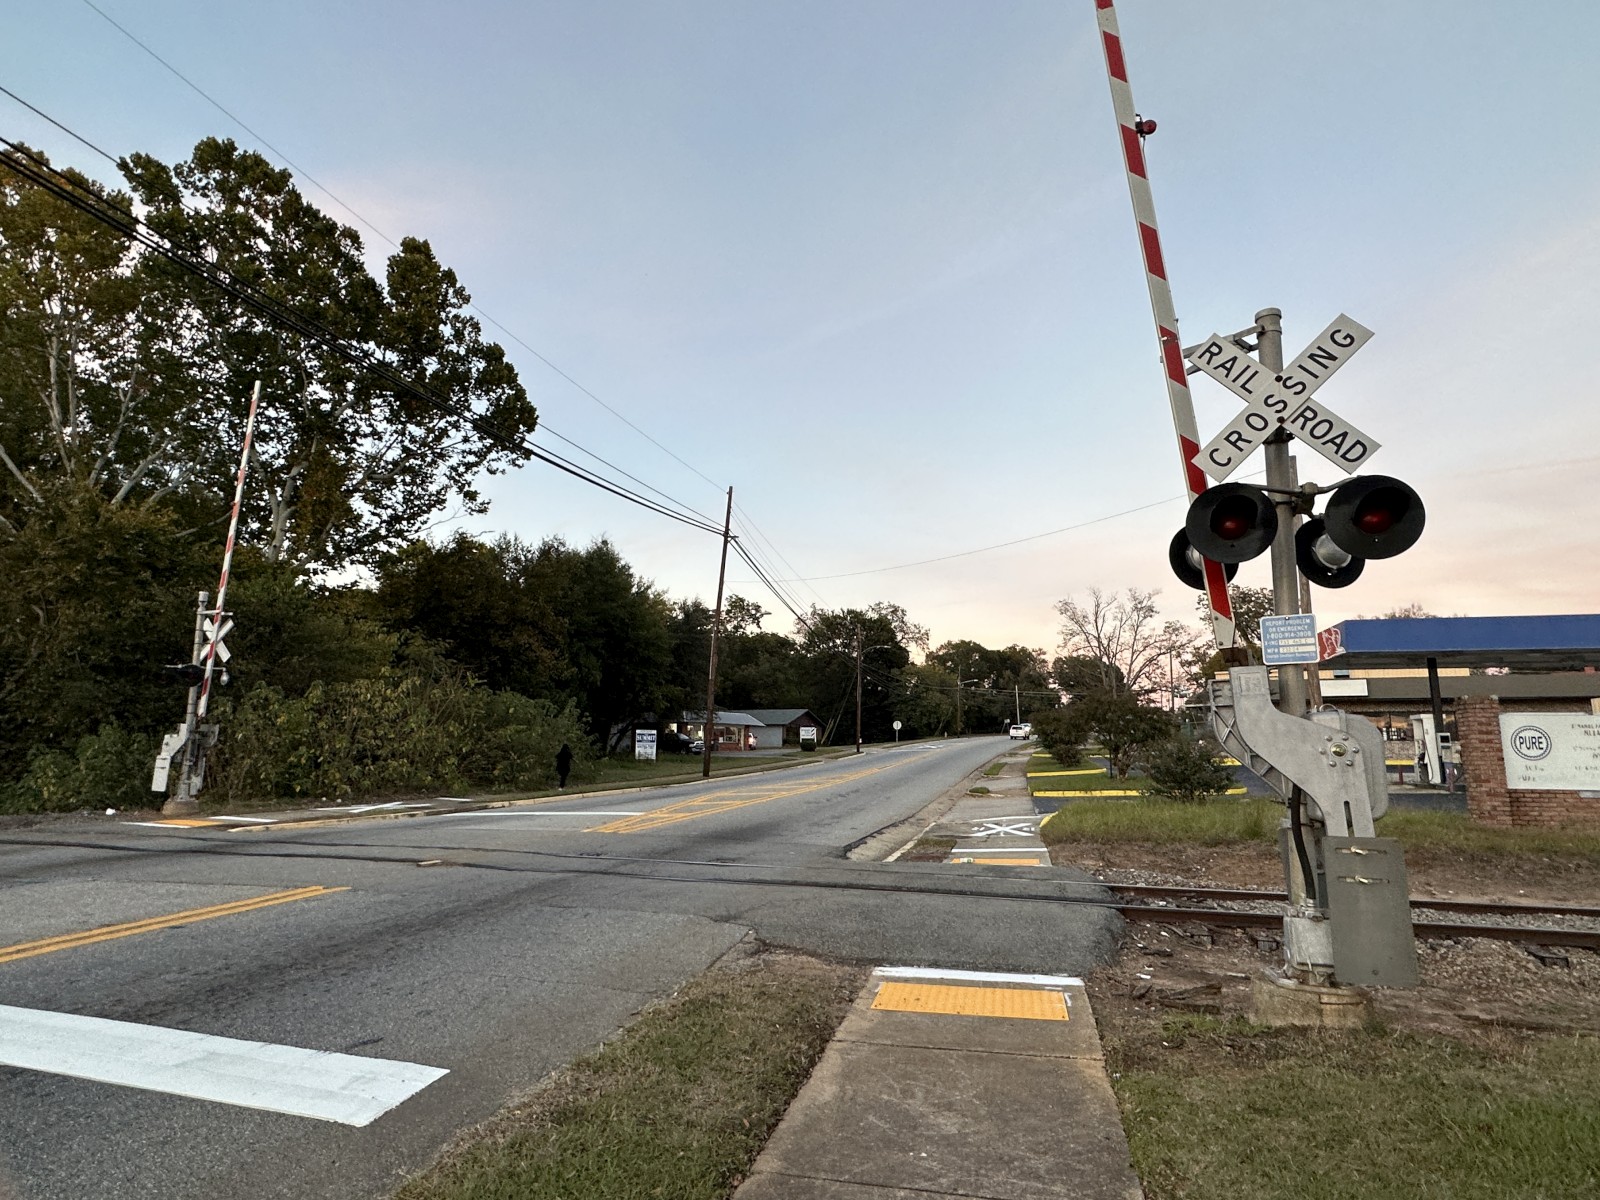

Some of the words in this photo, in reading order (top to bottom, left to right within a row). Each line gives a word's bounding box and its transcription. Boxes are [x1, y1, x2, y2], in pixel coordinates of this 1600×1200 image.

[1197, 341, 1260, 395] RAIL
[1208, 329, 1356, 468] CROSSING
[1290, 405, 1368, 463] ROAD
[1518, 735, 1544, 750] PURE
